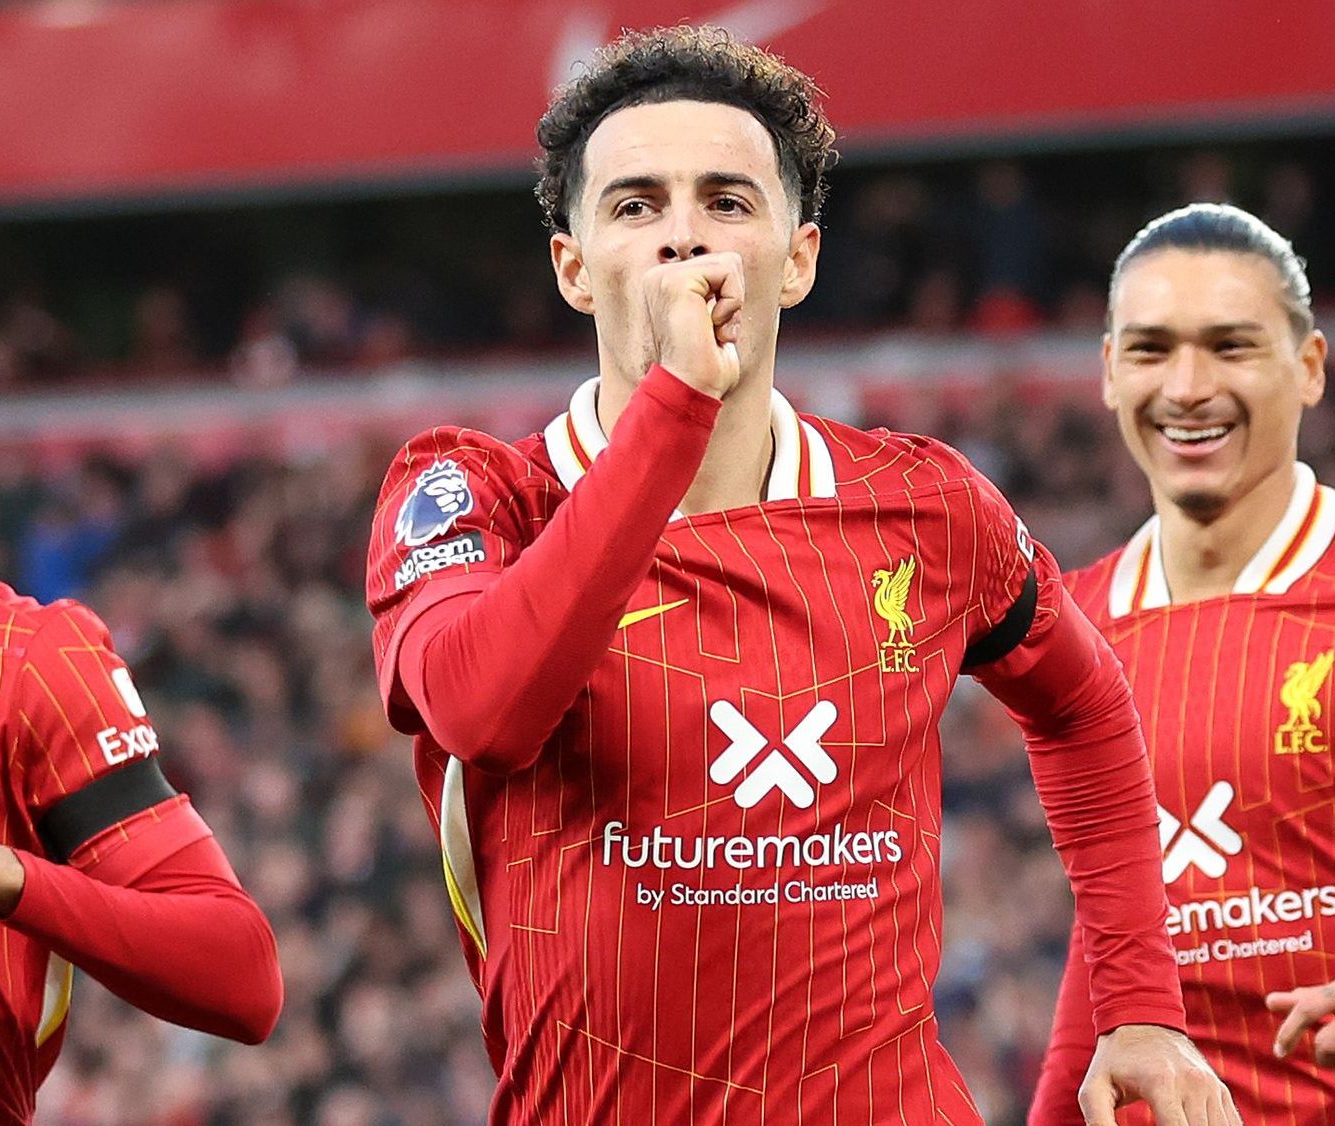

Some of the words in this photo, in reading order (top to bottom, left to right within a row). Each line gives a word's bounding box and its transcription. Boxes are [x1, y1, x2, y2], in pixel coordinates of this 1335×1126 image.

[412, 538, 474, 563] room
[602, 820, 902, 869] futuremakers
[636, 882, 667, 911] by
[670, 882, 779, 906] Standard
[784, 877, 879, 902] Chartered
[1212, 930, 1314, 961] Chartered
